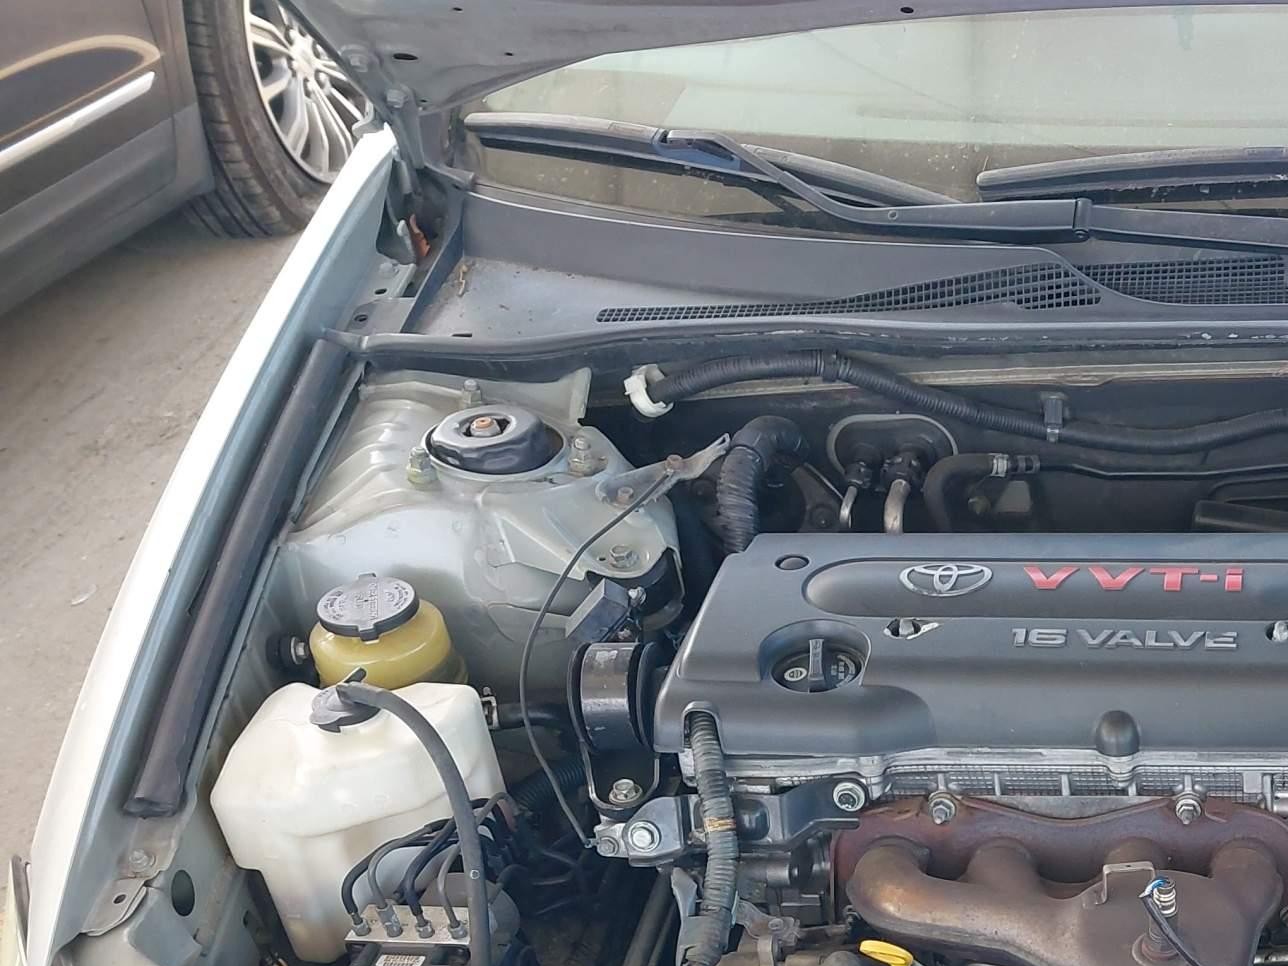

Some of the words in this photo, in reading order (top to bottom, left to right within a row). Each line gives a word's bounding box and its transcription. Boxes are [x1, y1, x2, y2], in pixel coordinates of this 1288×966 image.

[1023, 566, 1244, 592] VVT-i
[1011, 627, 1068, 649] 16
[1076, 628, 1239, 651] VALVE
